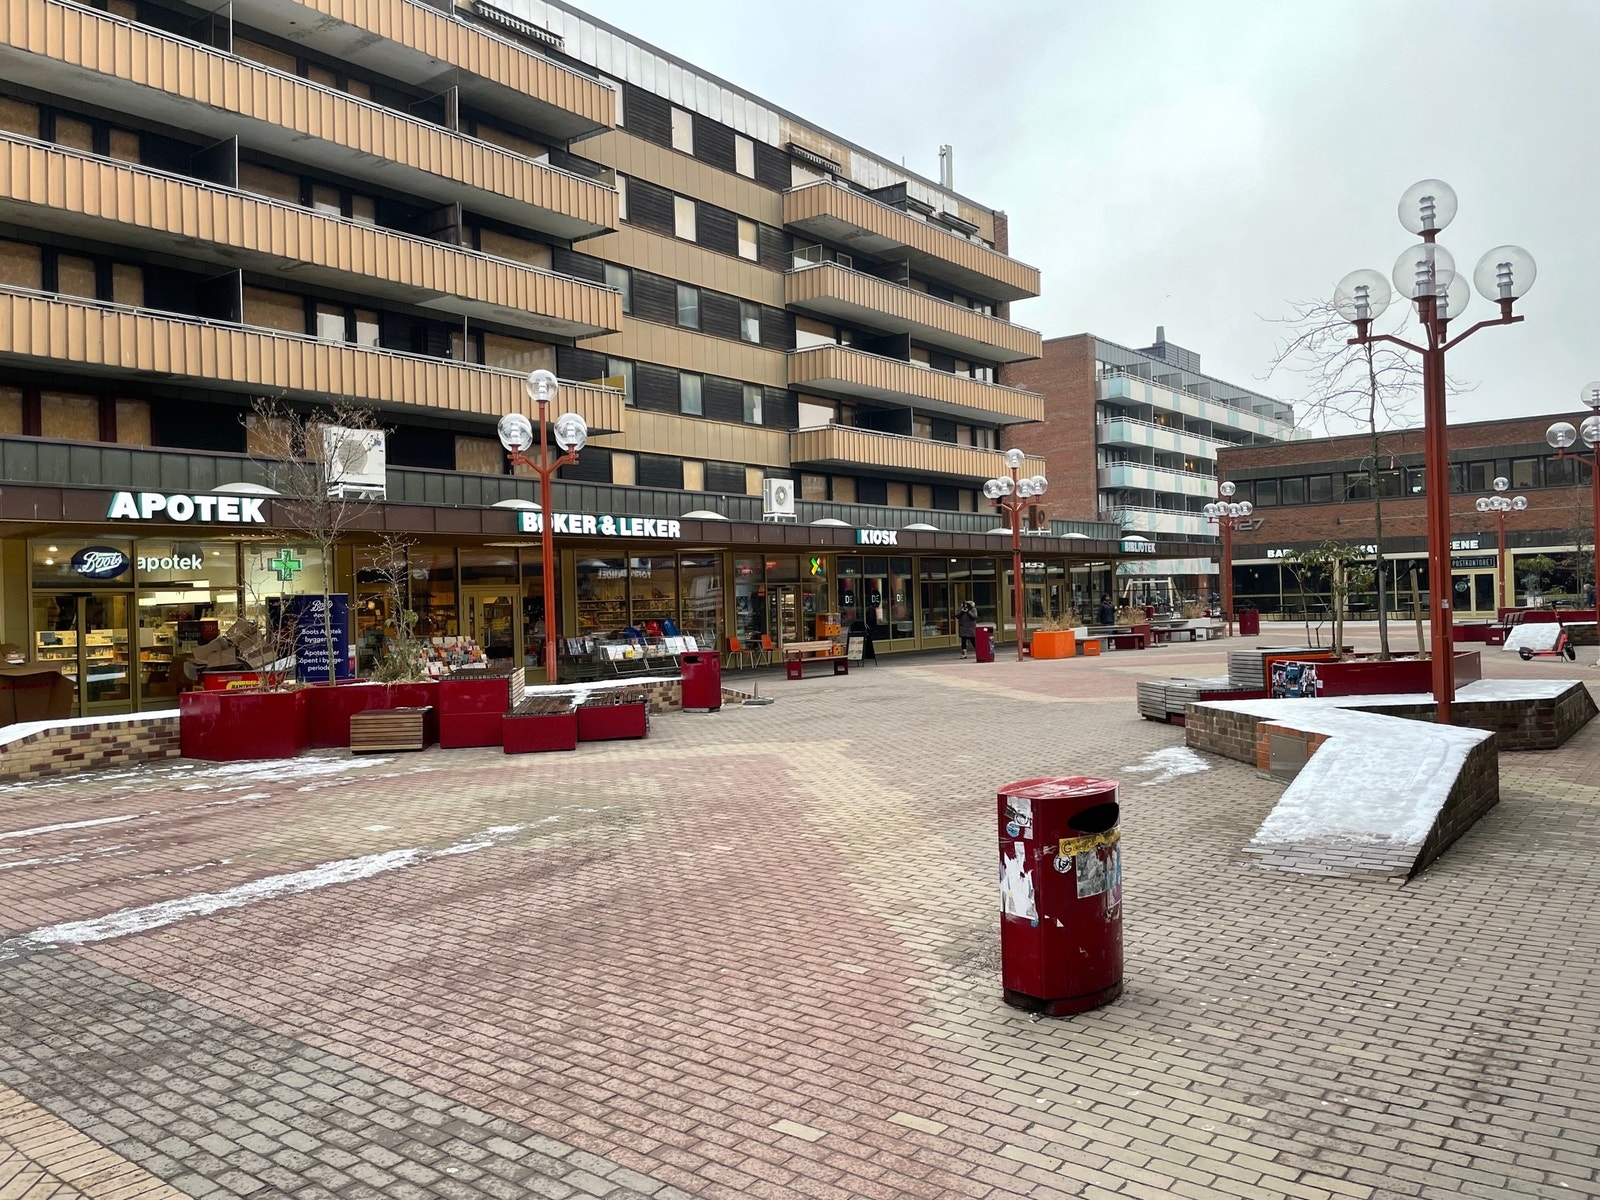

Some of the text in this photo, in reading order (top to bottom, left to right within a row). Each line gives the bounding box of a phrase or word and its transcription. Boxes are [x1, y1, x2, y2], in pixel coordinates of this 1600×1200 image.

[107, 491, 266, 523] APOTEK
[598, 515, 617, 536] &
[617, 517, 681, 538] LEKER
[857, 529, 898, 545] KIOSK
[1121, 541, 1156, 553] BIBLIOTEK
[1450, 540, 1479, 549] ENE
[78, 551, 202, 573] Boots apotek
[1452, 559, 1492, 567] POSTKONTORET
[310, 600, 333, 611] Bos
[320, 628, 342, 636] Aotek
